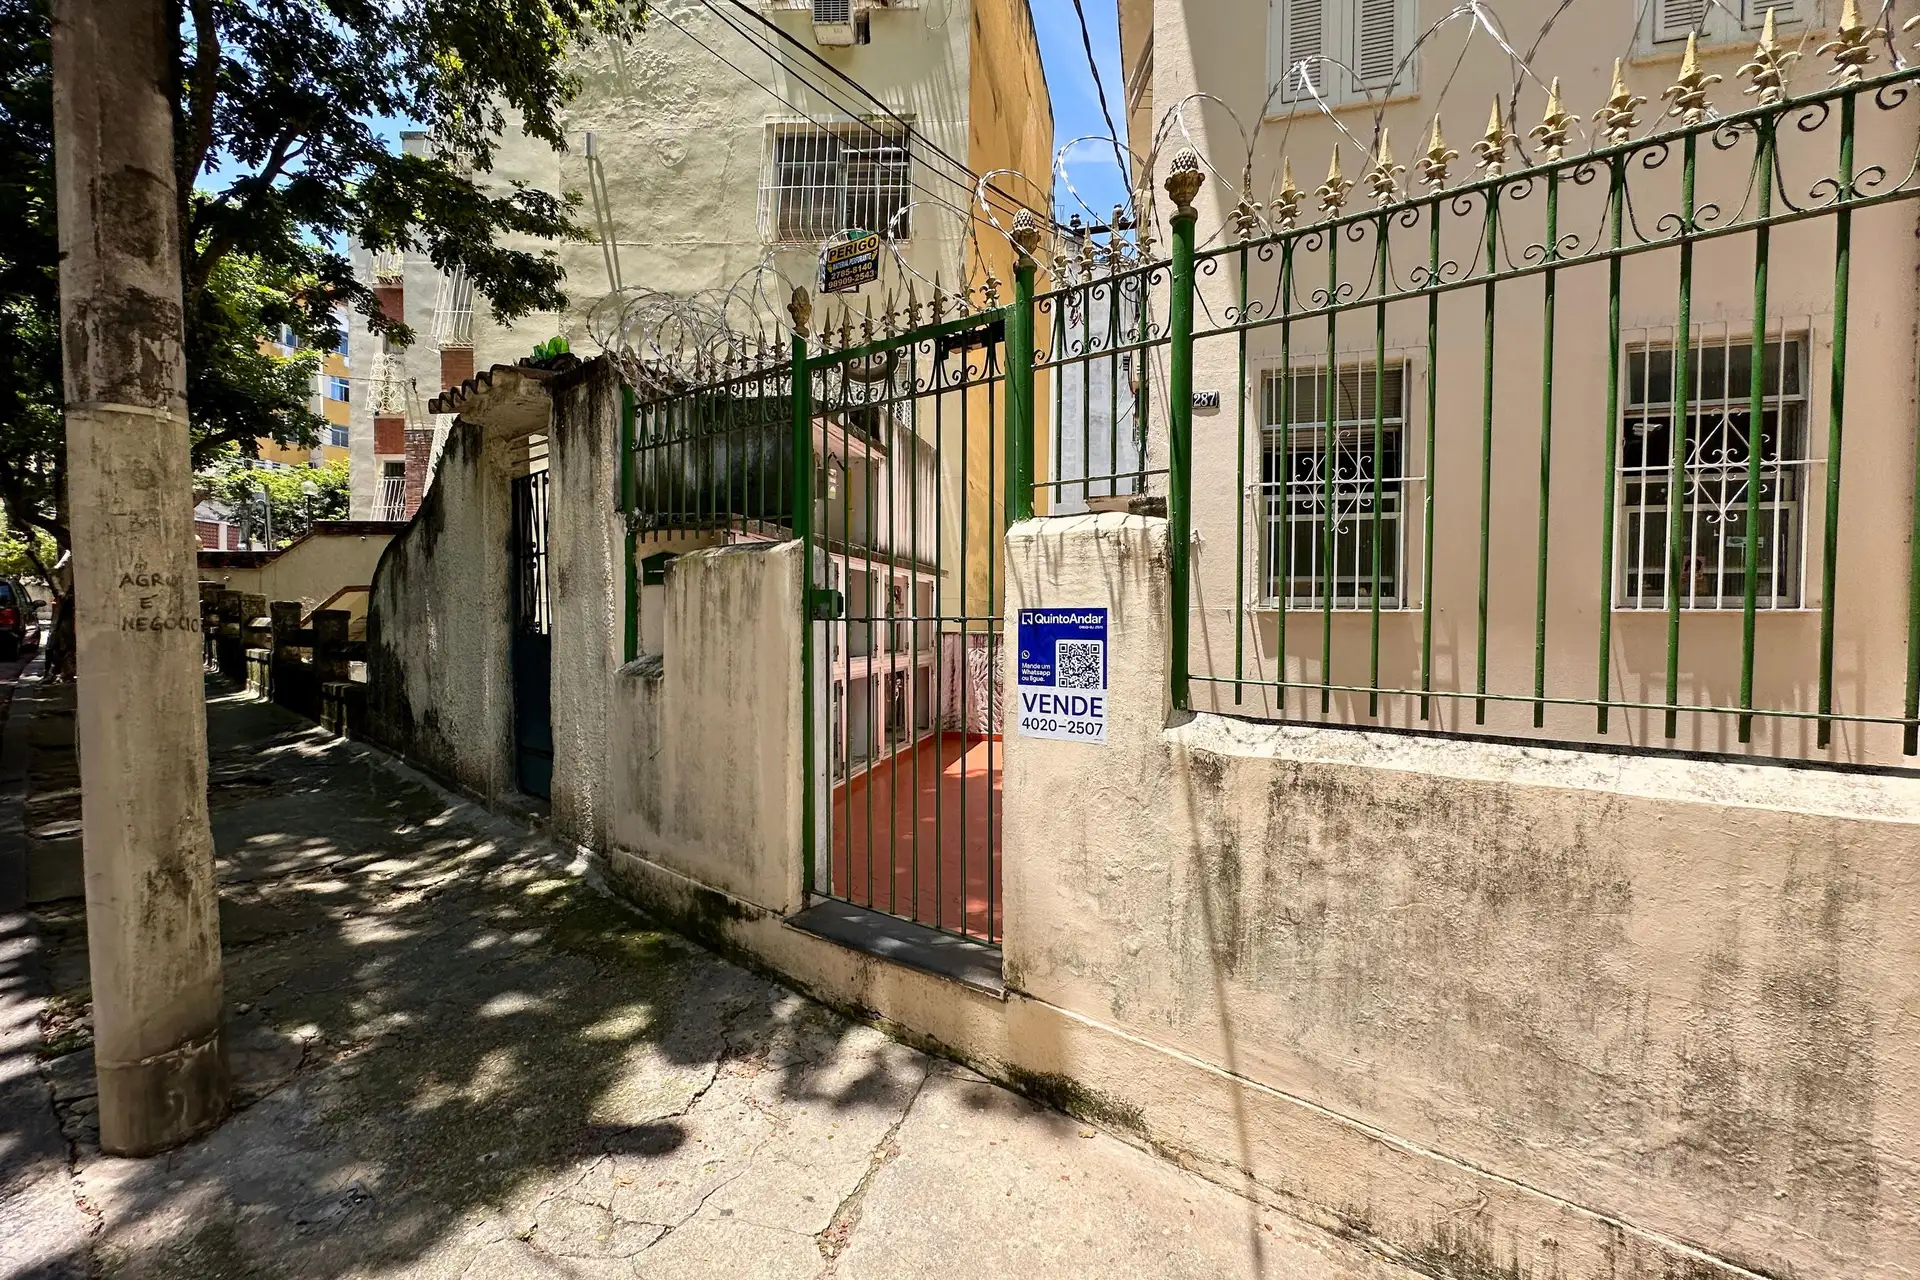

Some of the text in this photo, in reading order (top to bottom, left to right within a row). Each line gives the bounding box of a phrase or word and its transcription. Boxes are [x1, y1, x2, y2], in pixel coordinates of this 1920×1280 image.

[829, 236, 877, 262] PERIGO
[831, 261, 873, 280] 2785-8140
[1193, 392, 1216, 407] 287
[1034, 613, 1104, 625] QuintoAndar
[1022, 692, 1104, 718] VENDE
[1021, 717, 1104, 736] 4020-2507
